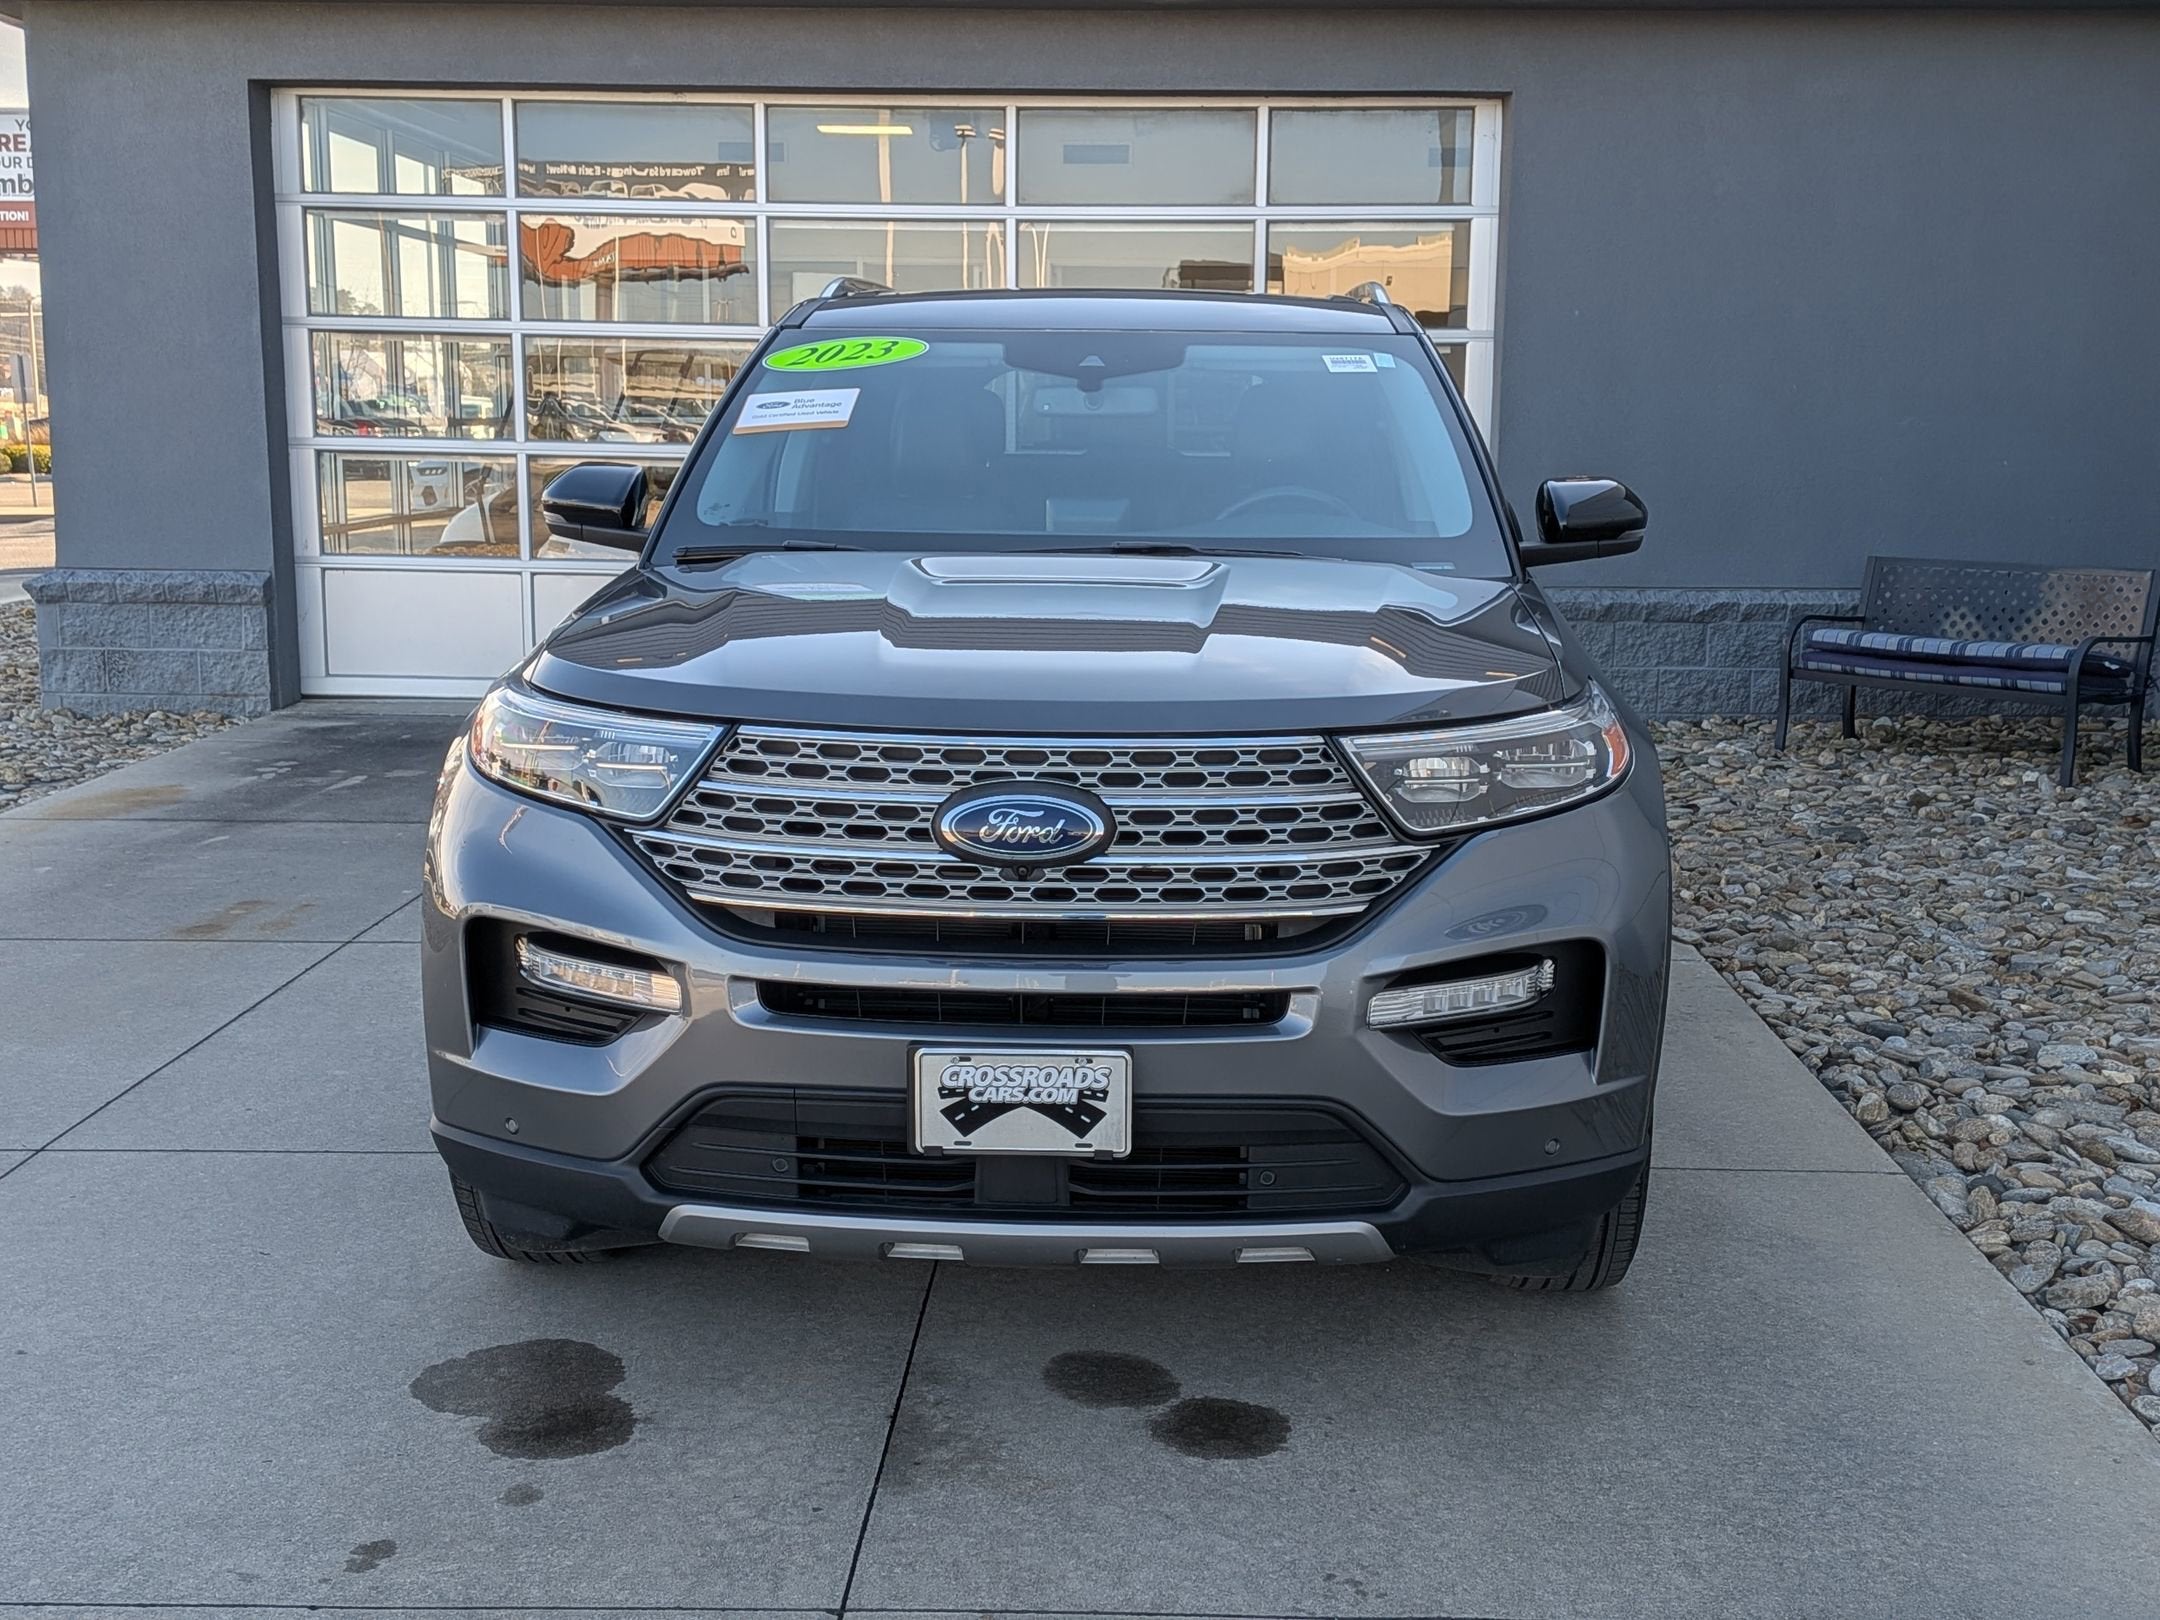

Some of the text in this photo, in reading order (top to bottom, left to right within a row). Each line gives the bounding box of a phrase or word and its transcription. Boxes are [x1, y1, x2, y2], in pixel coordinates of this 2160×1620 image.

[0, 133, 32, 152] RE
[0, 156, 22, 169] UR
[783, 340, 899, 366] 2023
[791, 401, 842, 409] Advantage
[979, 808, 1067, 845] Ford
[939, 1065, 1113, 1090] CROSSROADS
[967, 1085, 1080, 1105] CARS.COM
